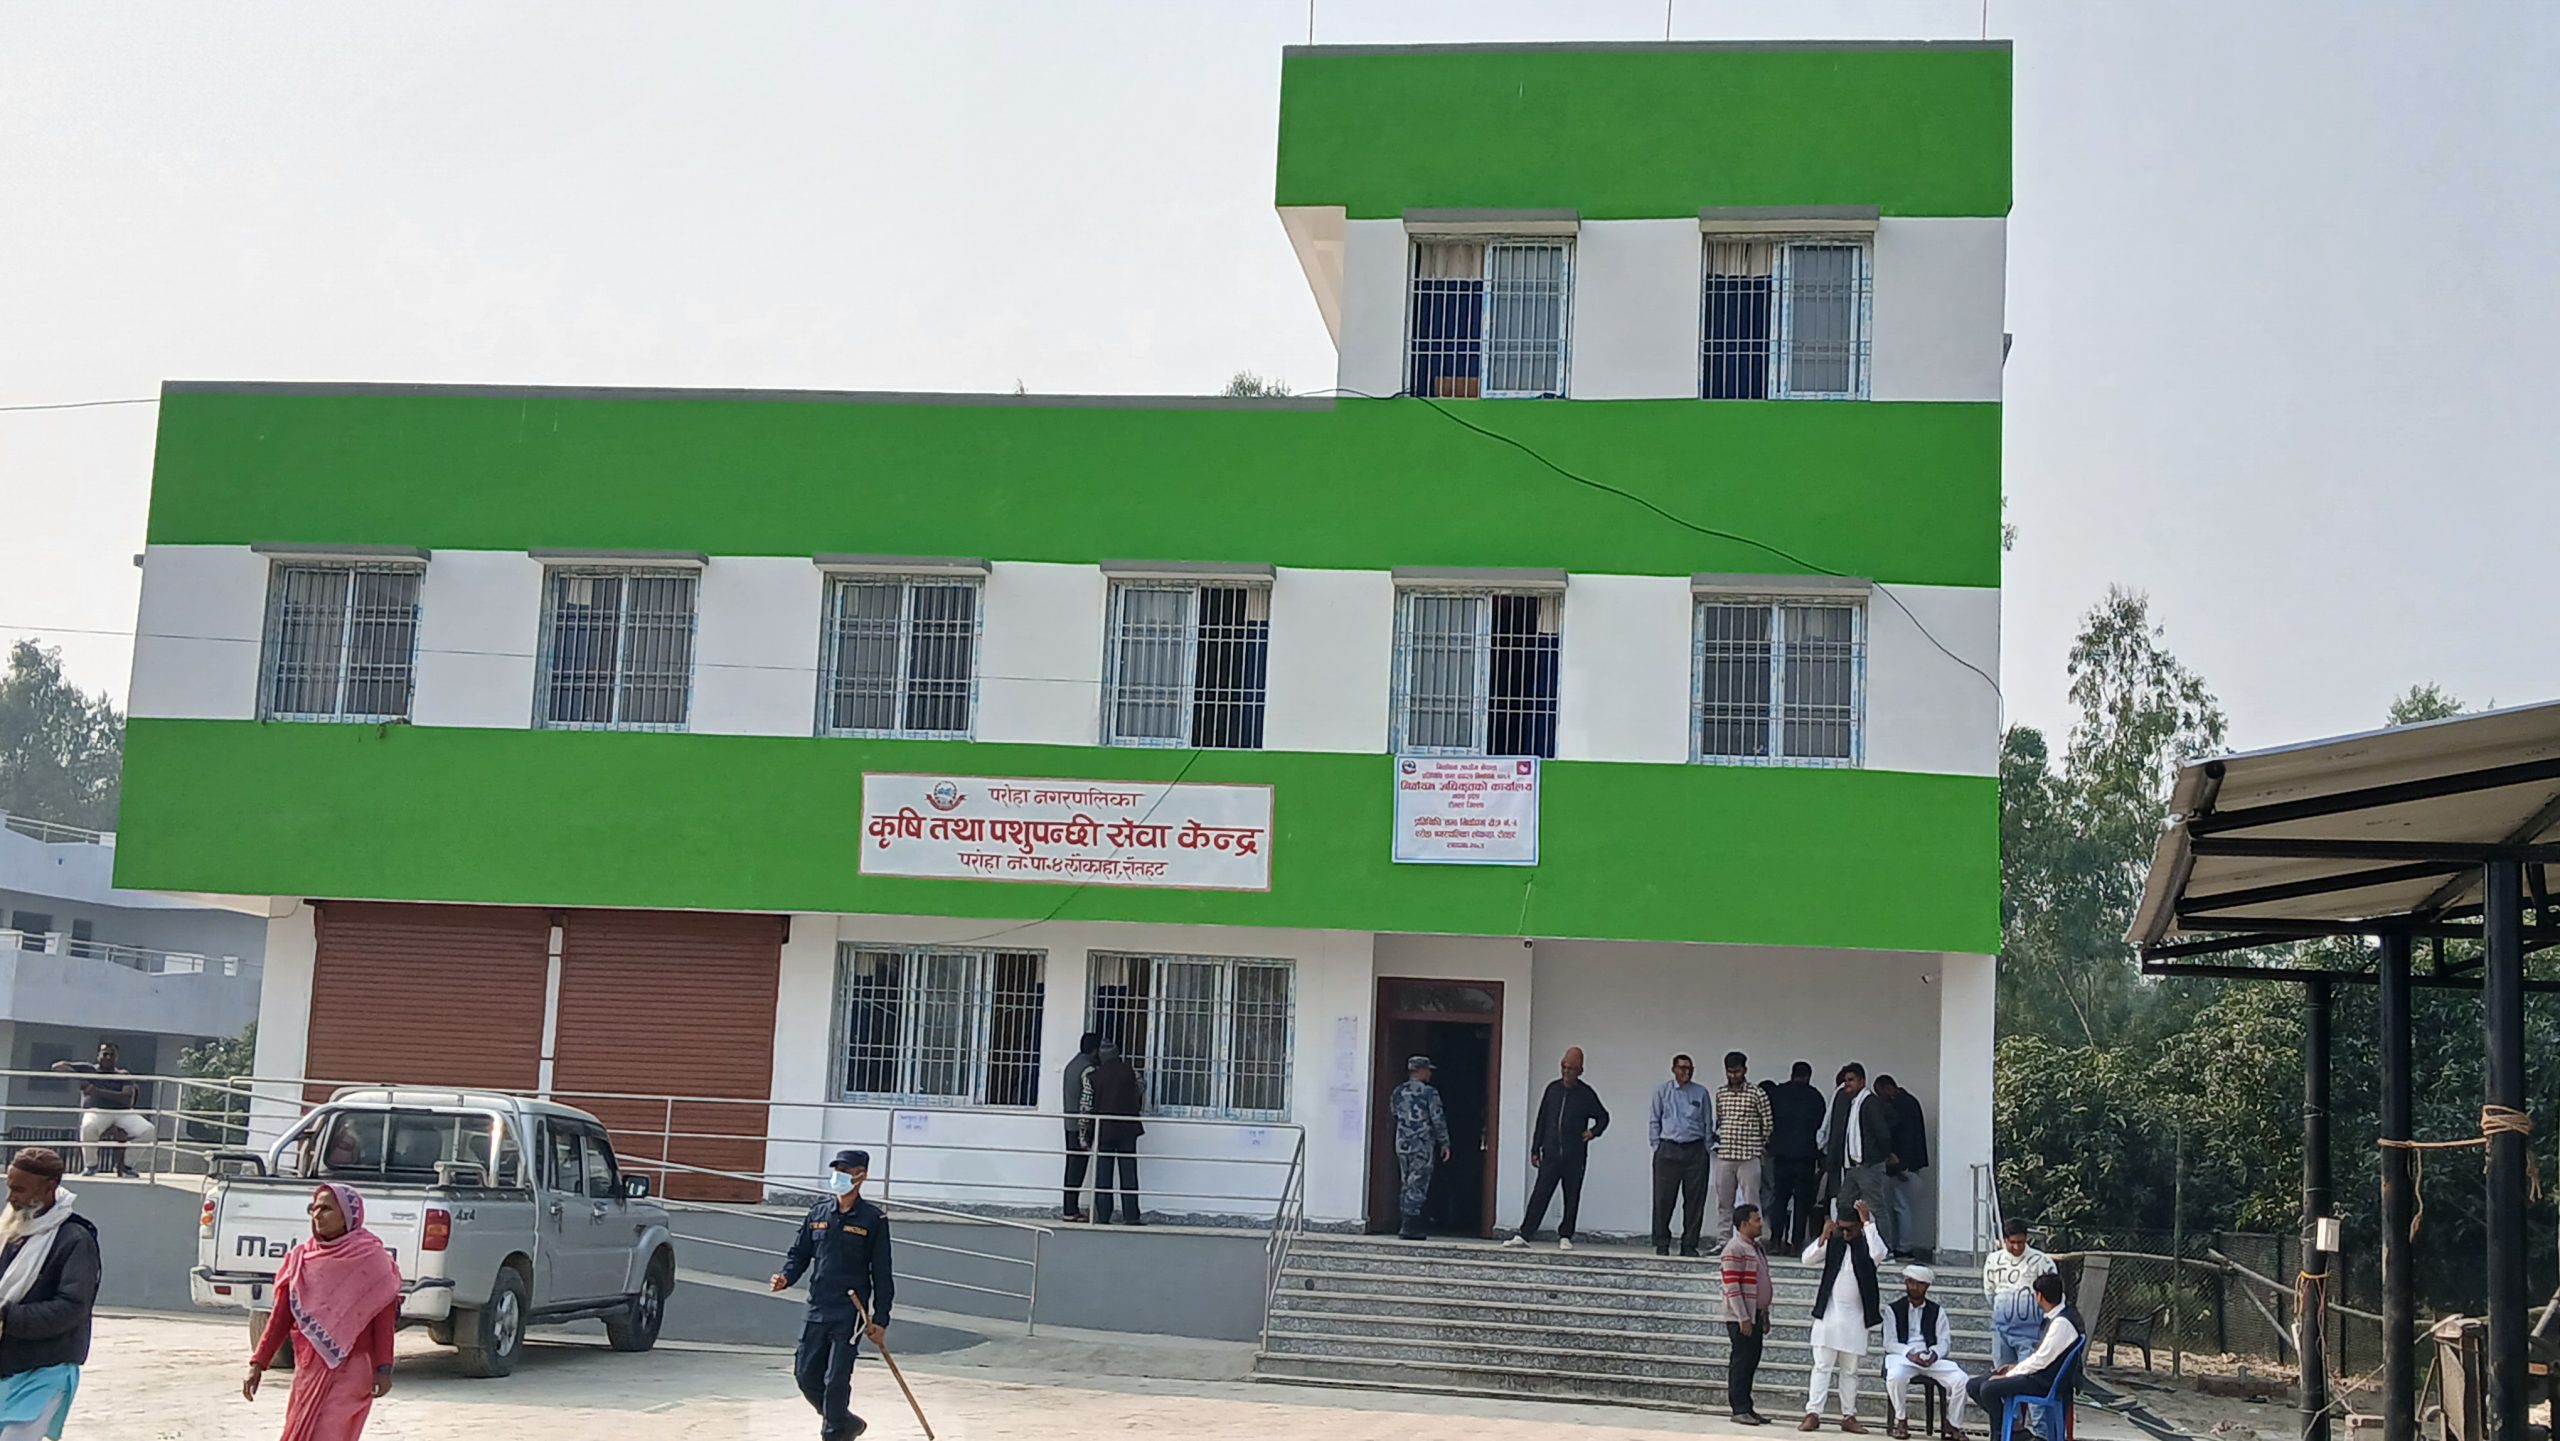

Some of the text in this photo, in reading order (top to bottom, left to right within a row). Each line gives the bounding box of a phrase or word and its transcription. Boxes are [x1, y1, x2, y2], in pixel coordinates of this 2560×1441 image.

[1033, 787, 1146, 810] नगरपालिका
[868, 806, 1265, 856] कृषि तथा पशुपन्छी सेवा केन्द्र
